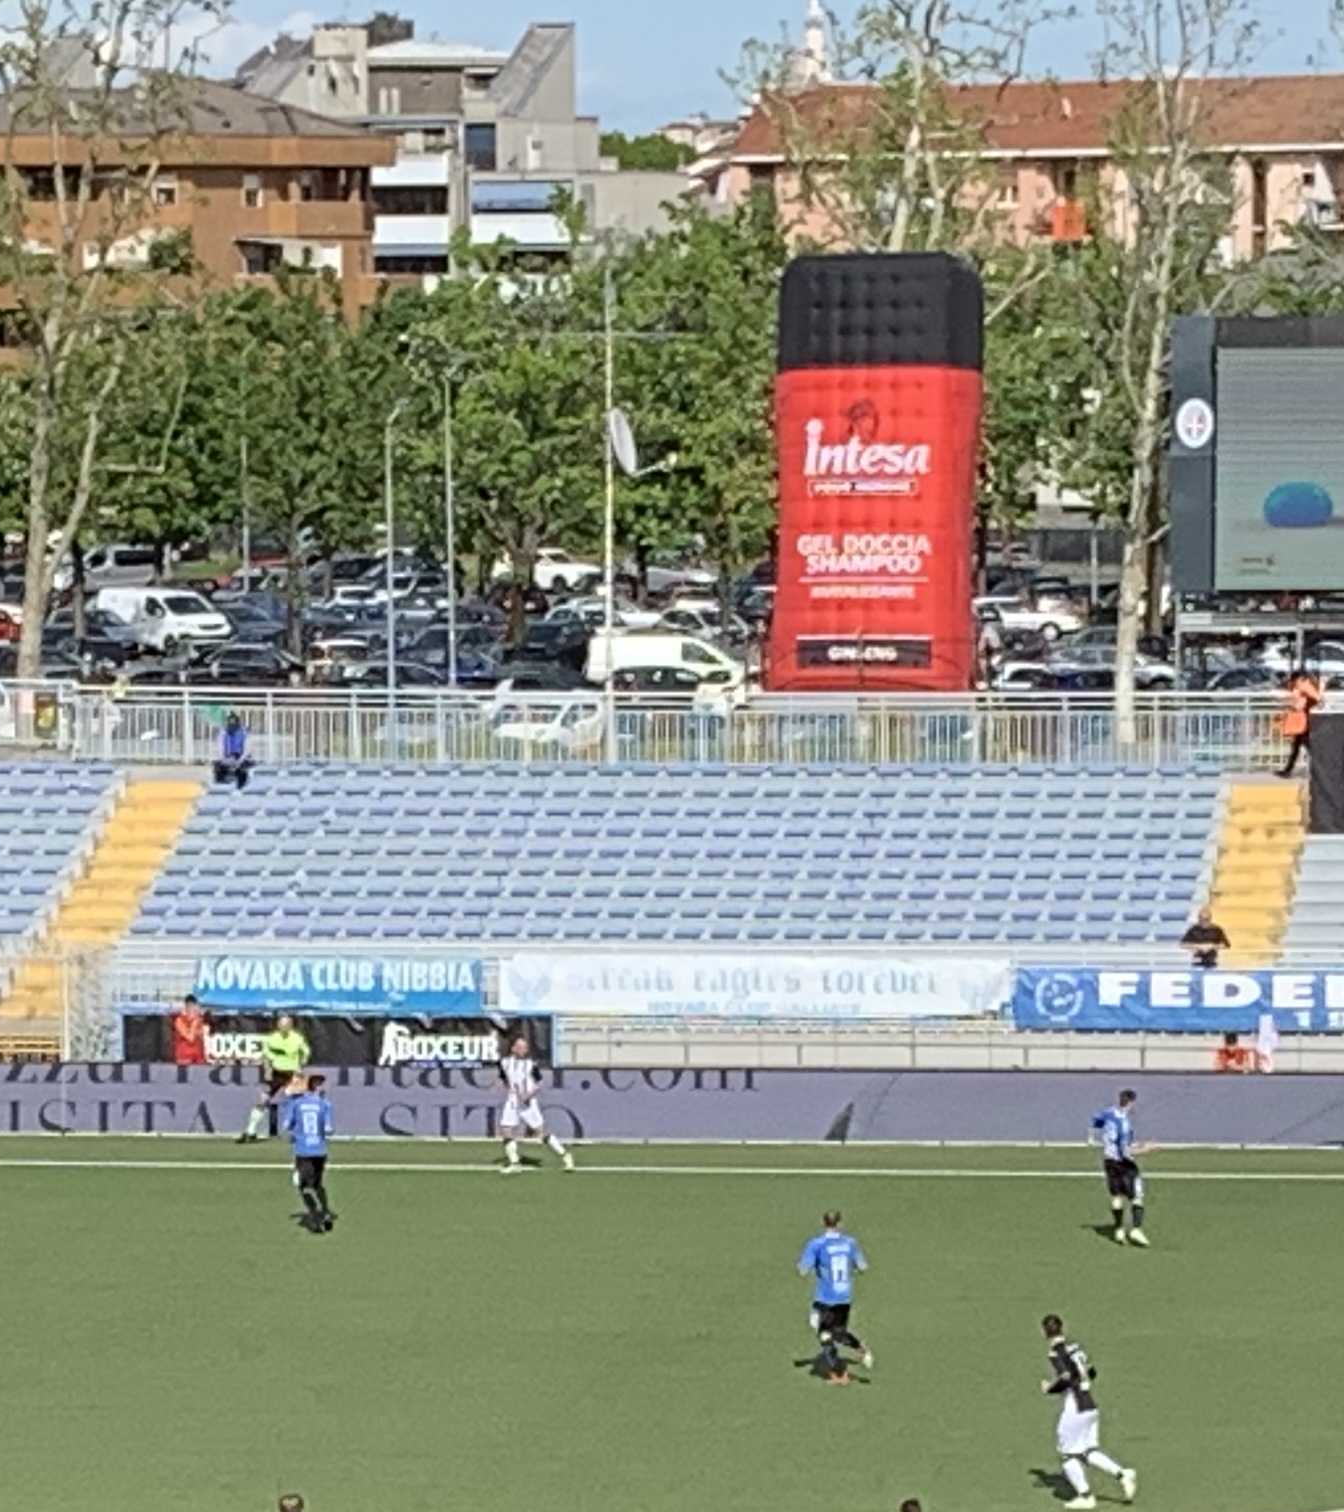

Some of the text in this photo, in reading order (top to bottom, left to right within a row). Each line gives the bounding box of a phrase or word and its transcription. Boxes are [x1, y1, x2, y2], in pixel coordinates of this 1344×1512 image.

[804, 418, 931, 475] Intesa
[796, 533, 933, 556] GEL DOCCIA
[806, 554, 923, 574] SHAMPOO
[198, 958, 477, 992] NOVARA CLUB NIBBIA
